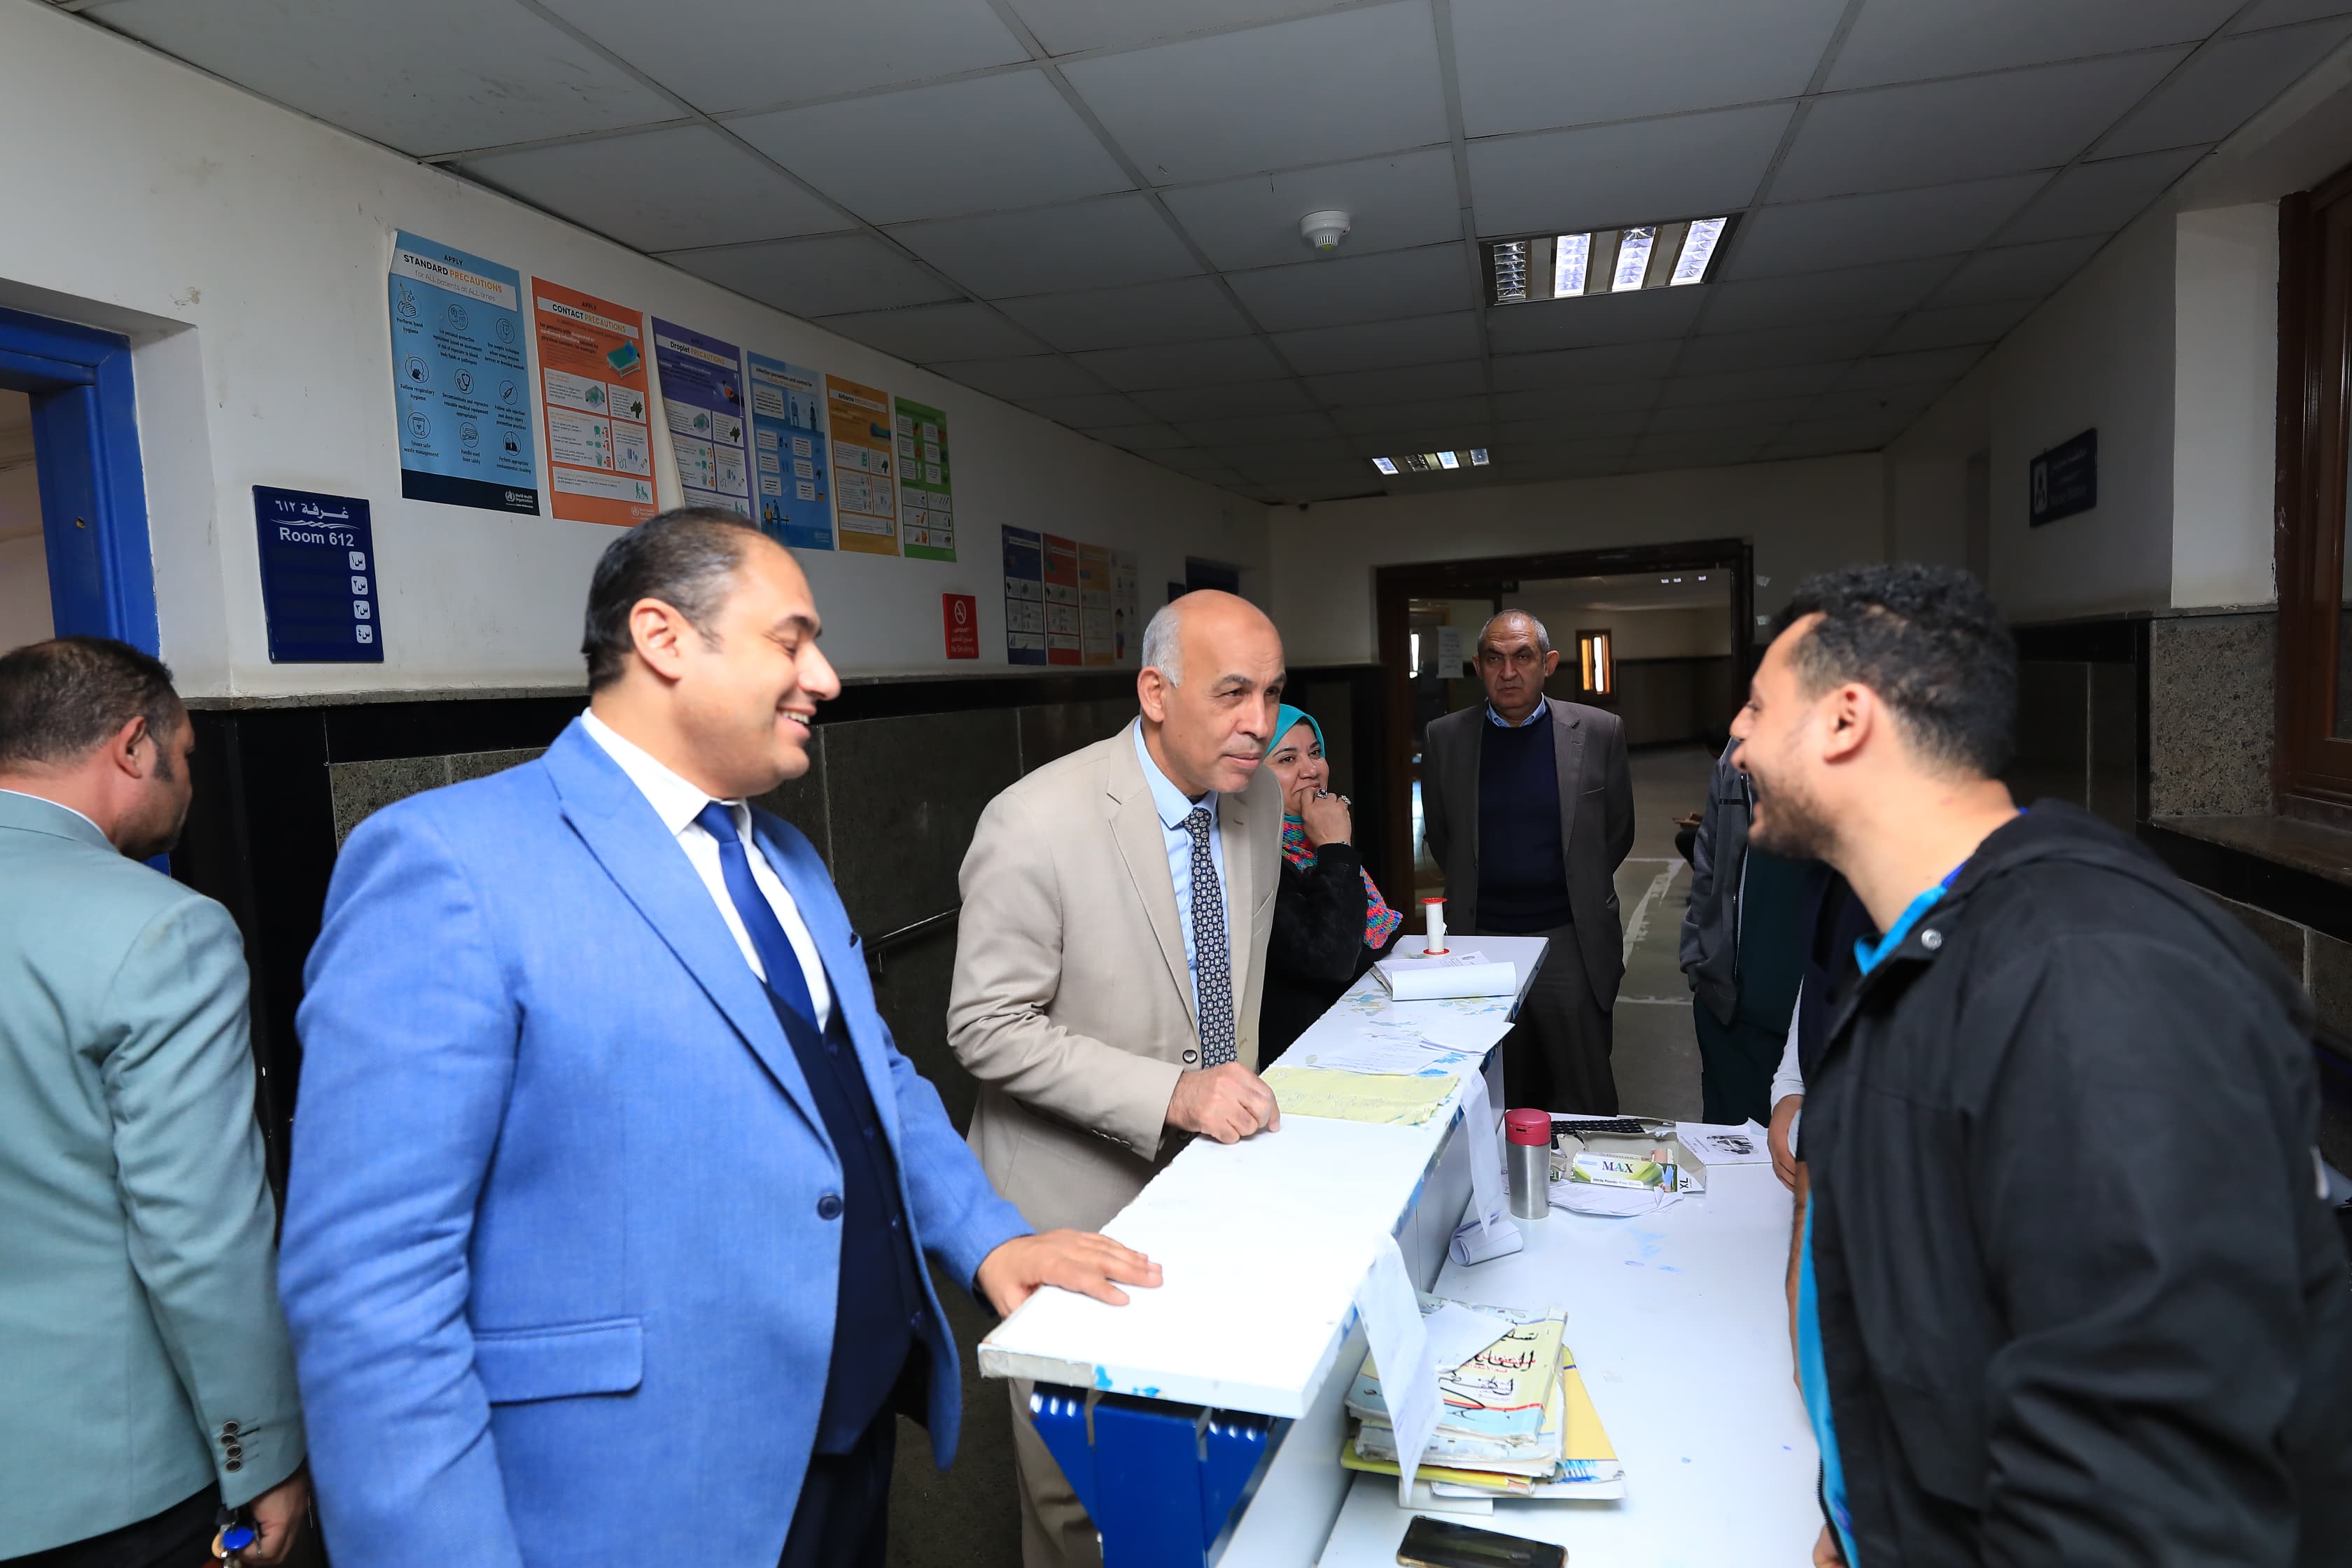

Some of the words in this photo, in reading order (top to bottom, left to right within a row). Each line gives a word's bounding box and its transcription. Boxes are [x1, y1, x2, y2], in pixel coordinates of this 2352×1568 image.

[444, 255, 463, 266] APPLY
[404, 255, 448, 274] STANDARD
[450, 270, 503, 293] PRECAUTIONS
[426, 273, 436, 283] ALL
[437, 278, 460, 290] patients
[469, 288, 479, 296] ALL
[481, 292, 496, 301] times
[553, 304, 583, 319] CONTACT
[585, 314, 625, 332] PRECAUTIONS
[540, 329, 561, 338] confirmed
[561, 333, 580, 343] infections
[671, 342, 690, 353] Droplet
[691, 348, 724, 365] PRECAUTIONS
[756, 367, 770, 375] Infection
[771, 372, 789, 381] prevention
[414, 386, 435, 396] respiratory
[471, 407, 489, 415] equipment
[275, 500, 295, 512] ٦١٢
[300, 502, 349, 519] غرفة
[279, 526, 325, 545] Room
[329, 532, 355, 547] 612
[351, 555, 363, 567] س١
[354, 580, 366, 591] س٢
[356, 605, 368, 615] س٣
[358, 628, 370, 640] س٤
[1602, 1161, 1633, 1173] MAX
[1679, 1177, 1688, 1189] XL
